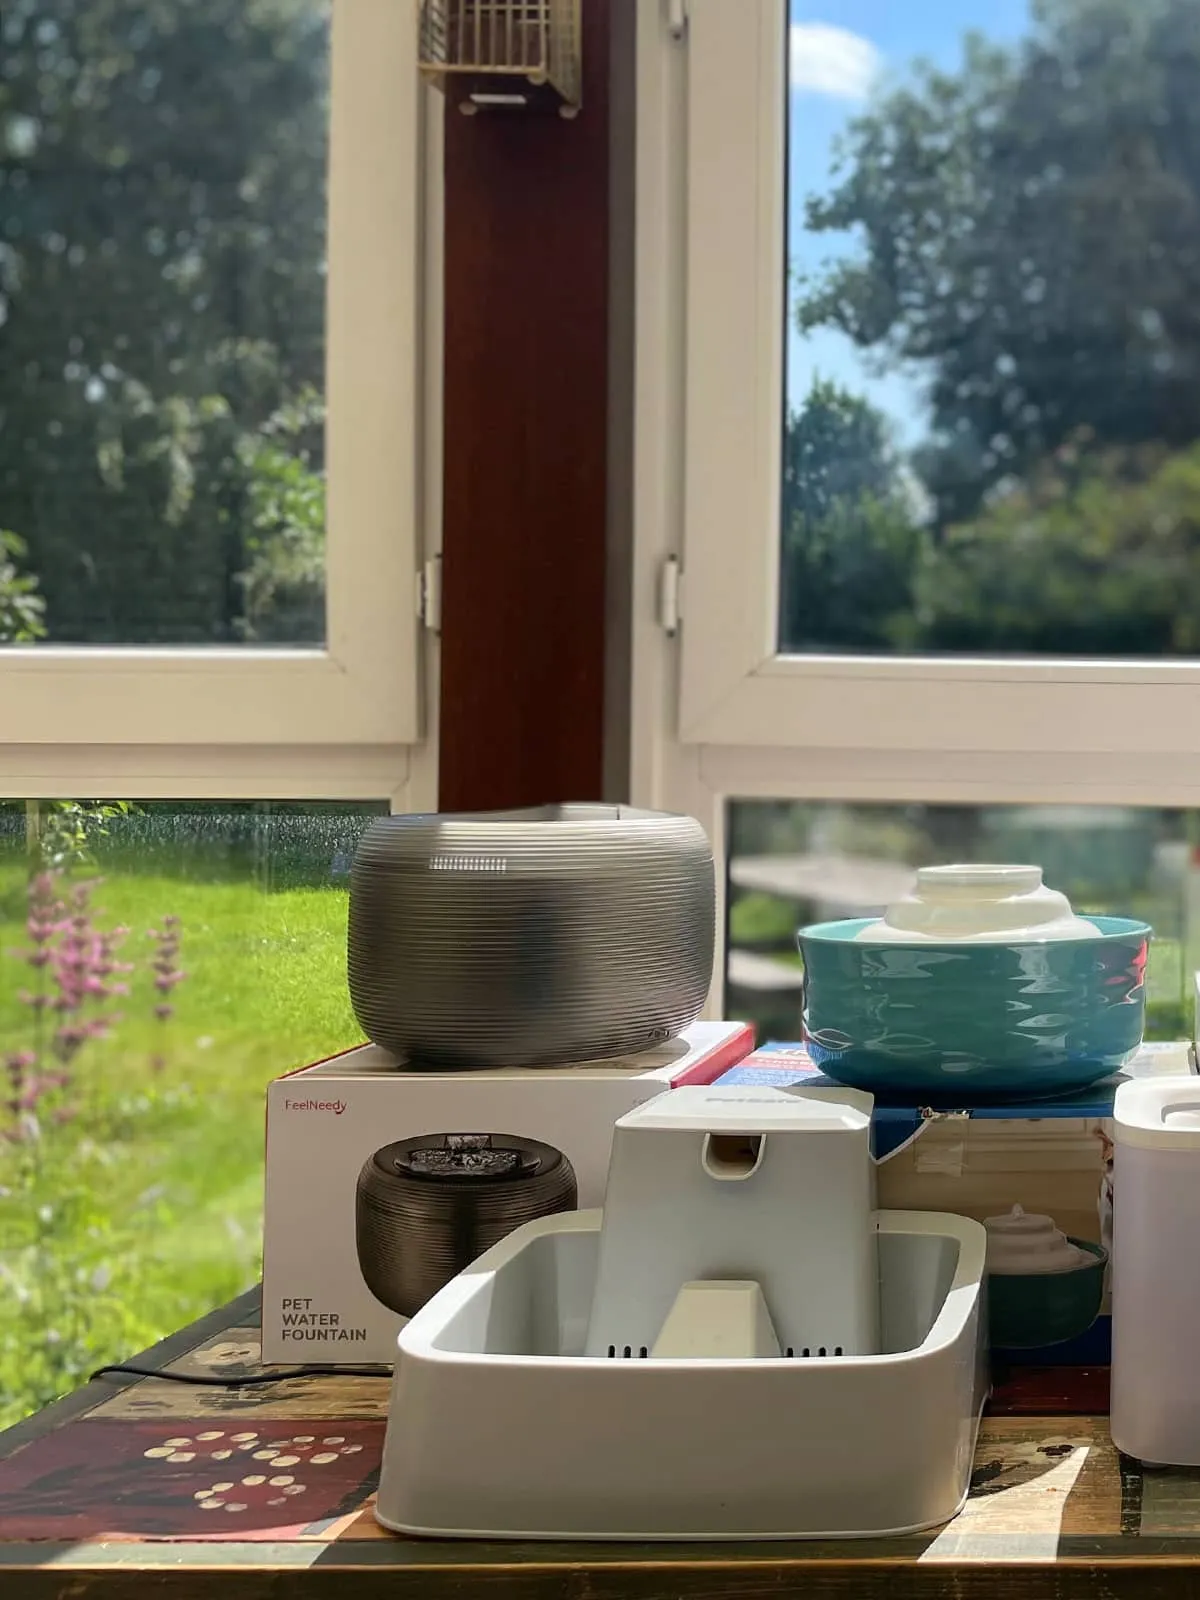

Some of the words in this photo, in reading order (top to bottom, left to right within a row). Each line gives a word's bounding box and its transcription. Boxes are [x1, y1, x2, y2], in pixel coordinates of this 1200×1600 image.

[284, 1099, 347, 1115] FeelNeedy
[282, 1298, 313, 1310] PET
[282, 1313, 341, 1326] WATER
[281, 1328, 367, 1341] FOUNTAIN
